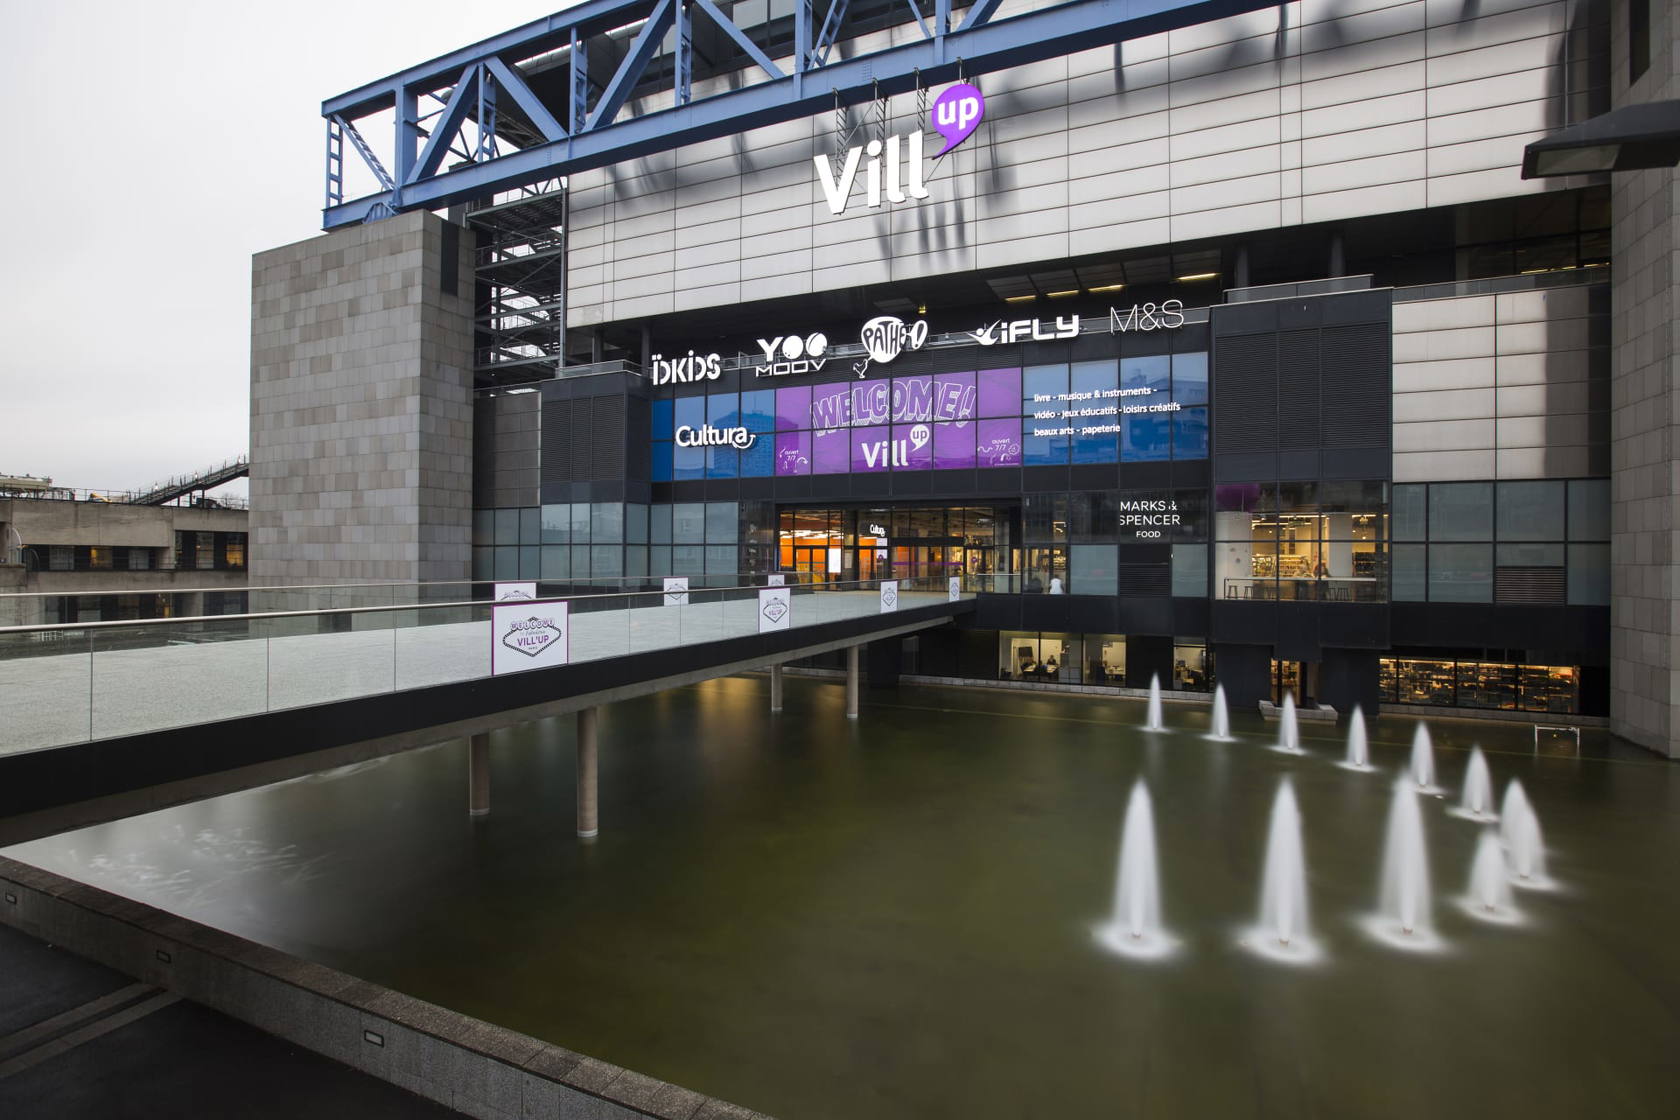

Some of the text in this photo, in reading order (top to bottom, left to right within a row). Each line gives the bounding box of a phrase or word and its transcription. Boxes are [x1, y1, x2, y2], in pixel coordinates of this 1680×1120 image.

[813, 97, 979, 214] Vill up
[1110, 299, 1184, 334] M&S
[1001, 314, 1080, 344] iFLY
[756, 332, 828, 362] YOO
[755, 358, 827, 377] MOOV
[1034, 394, 1051, 402] livre
[1058, 392, 1092, 402] musique
[1094, 390, 1101, 398] &
[1102, 386, 1152, 398] instruments
[810, 379, 977, 437] WELCOME!
[1034, 410, 1056, 420] vidéo
[1061, 410, 1079, 420] jeux
[1080, 406, 1118, 416] éducatifs
[1124, 404, 1148, 414] loisirs
[1149, 402, 1181, 412] créatifs
[674, 425, 751, 449] Cultura
[1034, 428, 1058, 436] beaux
[1082, 424, 1120, 436] papeterie
[862, 429, 928, 468] Vill up
[1120, 500, 1178, 512] MARKS &
[1120, 514, 1180, 526] SPENCER
[517, 634, 550, 646] VILL'UP
